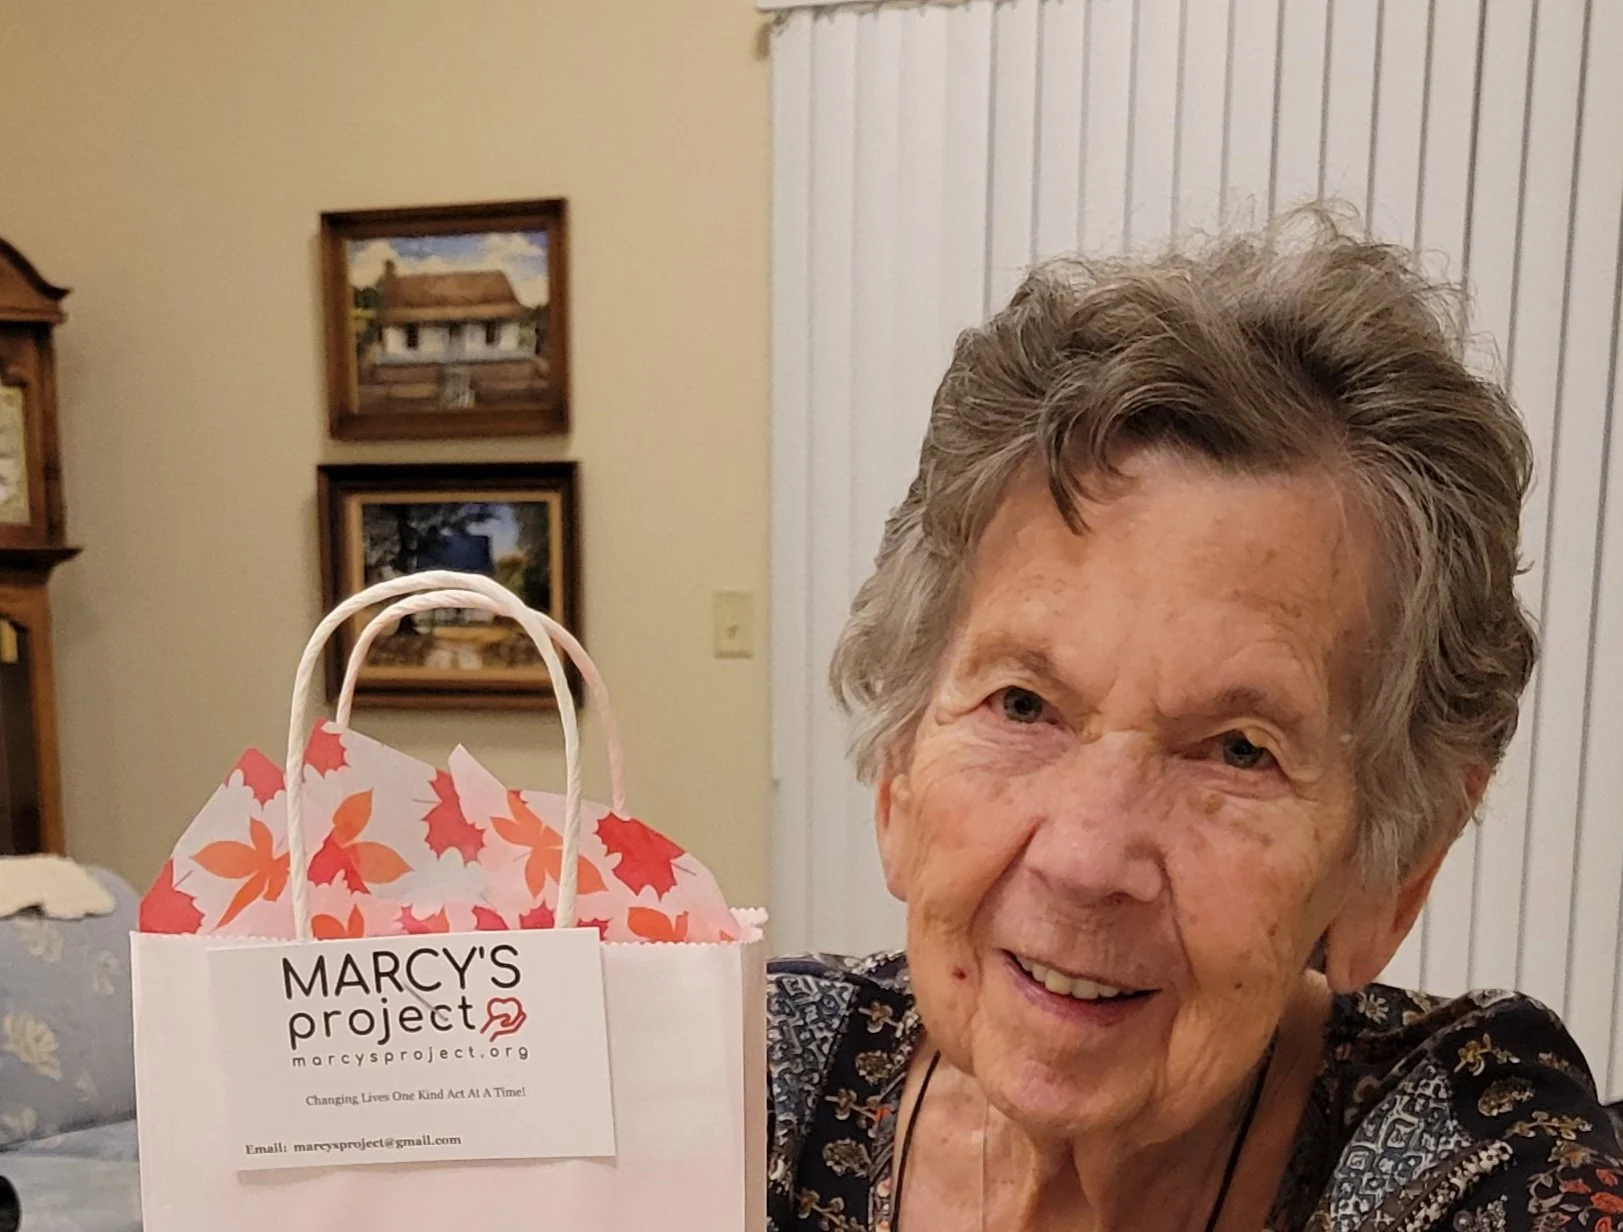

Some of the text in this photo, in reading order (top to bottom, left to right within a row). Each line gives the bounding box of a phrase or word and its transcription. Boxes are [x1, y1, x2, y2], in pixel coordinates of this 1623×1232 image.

[281, 944, 522, 999] MARCY'S
[288, 996, 477, 1050] project
[292, 1046, 530, 1067] marcysproject.org
[305, 1086, 527, 1107] Changing Lives One Kind Act At A Time!
[245, 1134, 462, 1156] Email: marcysproject@gmail.com
